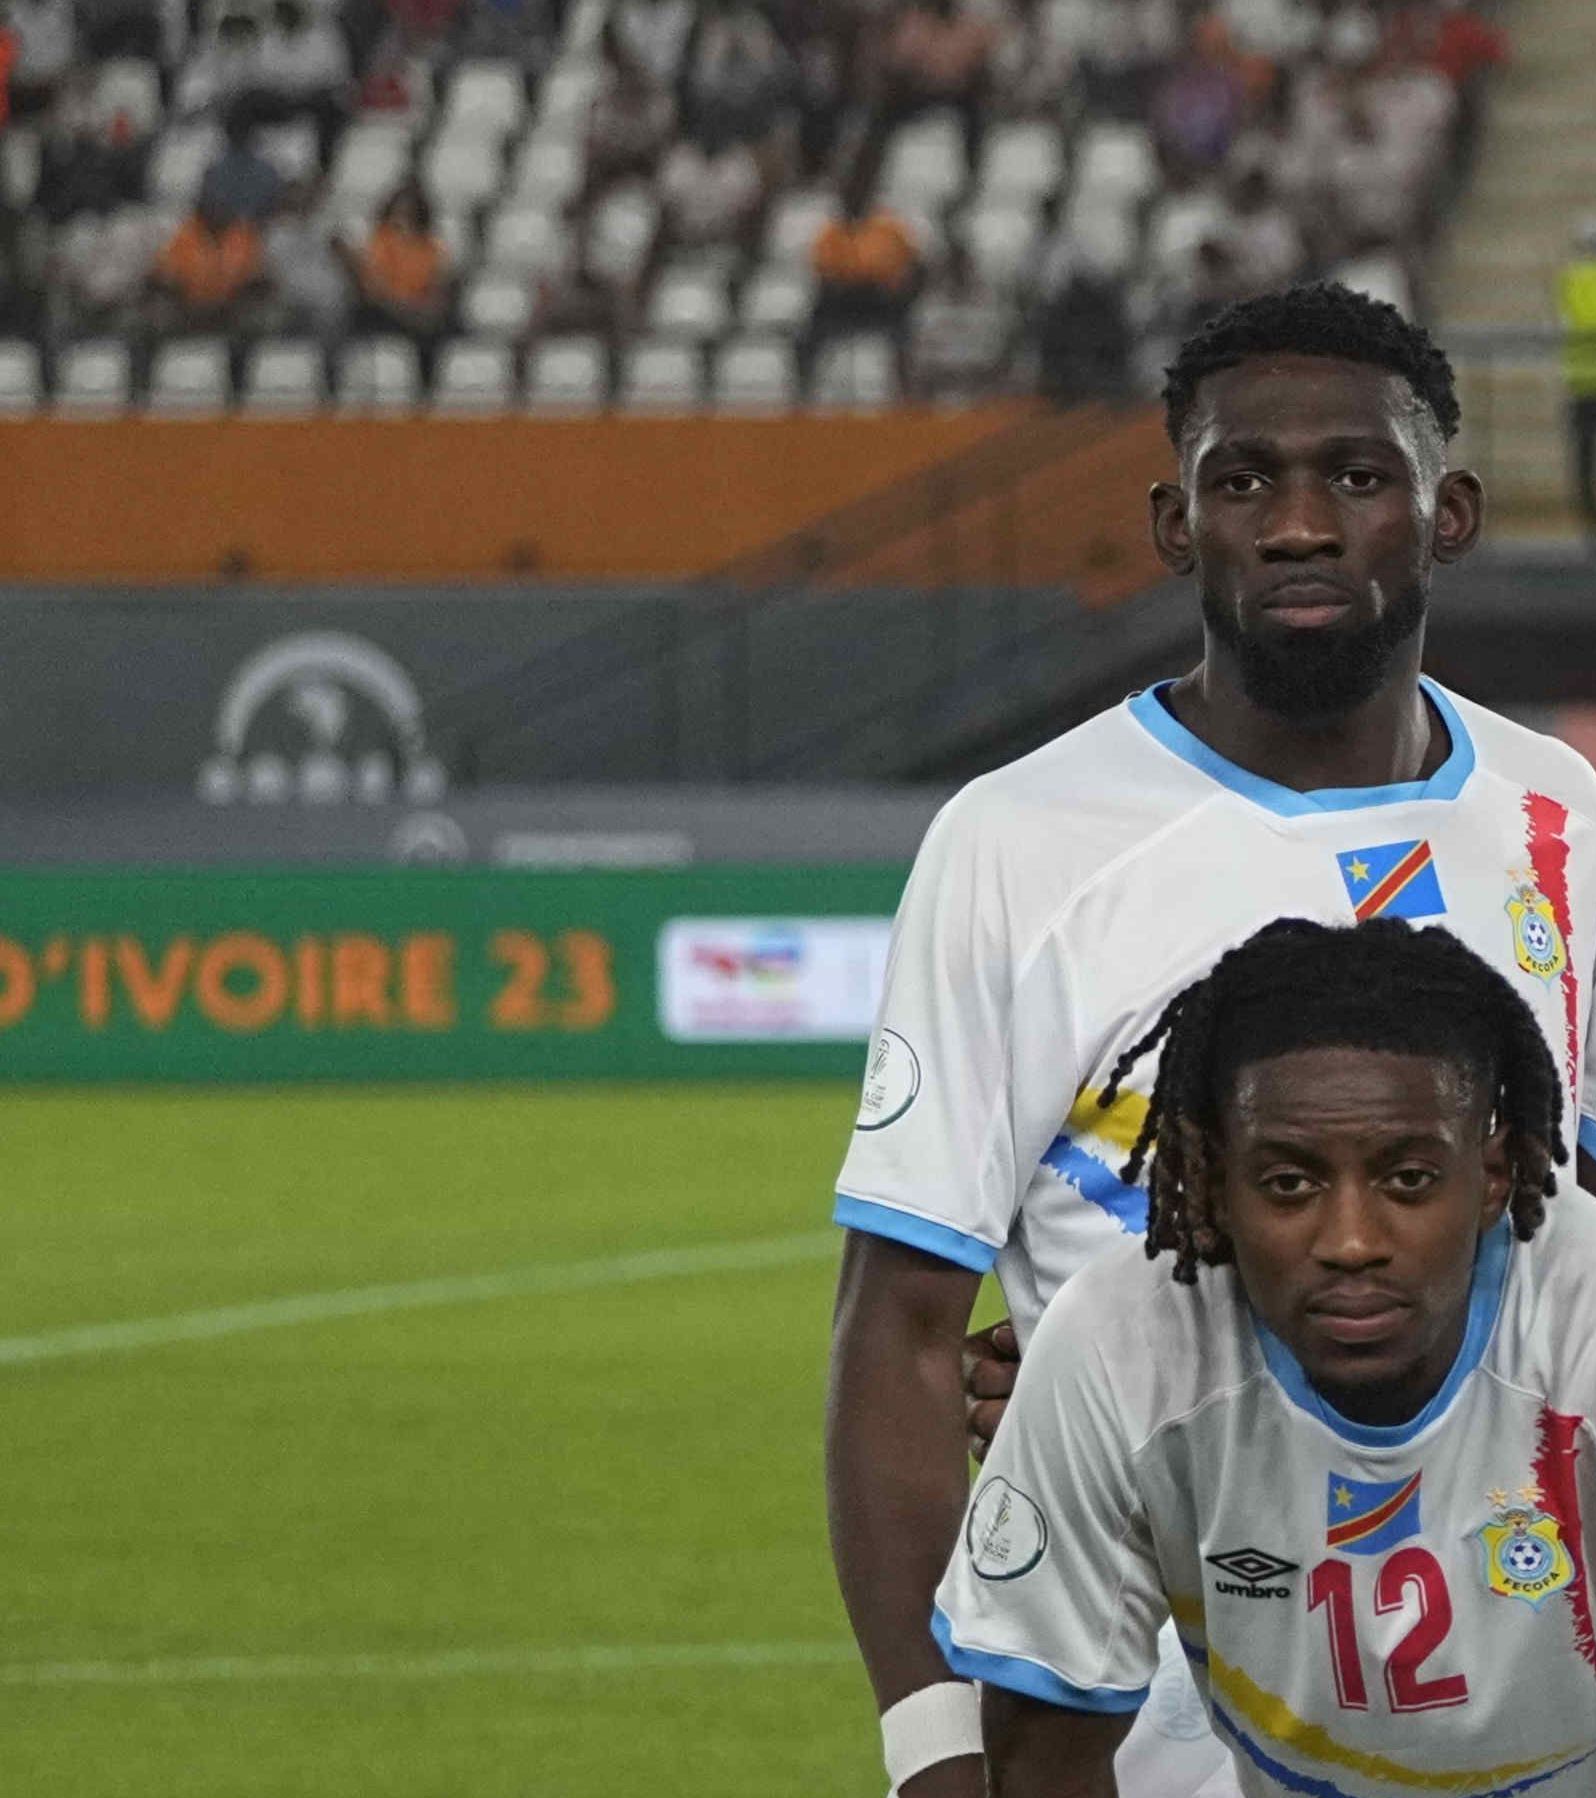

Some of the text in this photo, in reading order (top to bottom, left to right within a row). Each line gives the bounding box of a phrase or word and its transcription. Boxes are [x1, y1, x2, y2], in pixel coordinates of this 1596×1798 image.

[488, 928, 616, 1033] 23
[1215, 1580, 1290, 1600] umbro
[1503, 1572, 1560, 1592] FECOFA
[1308, 1547, 1468, 1714] 12
